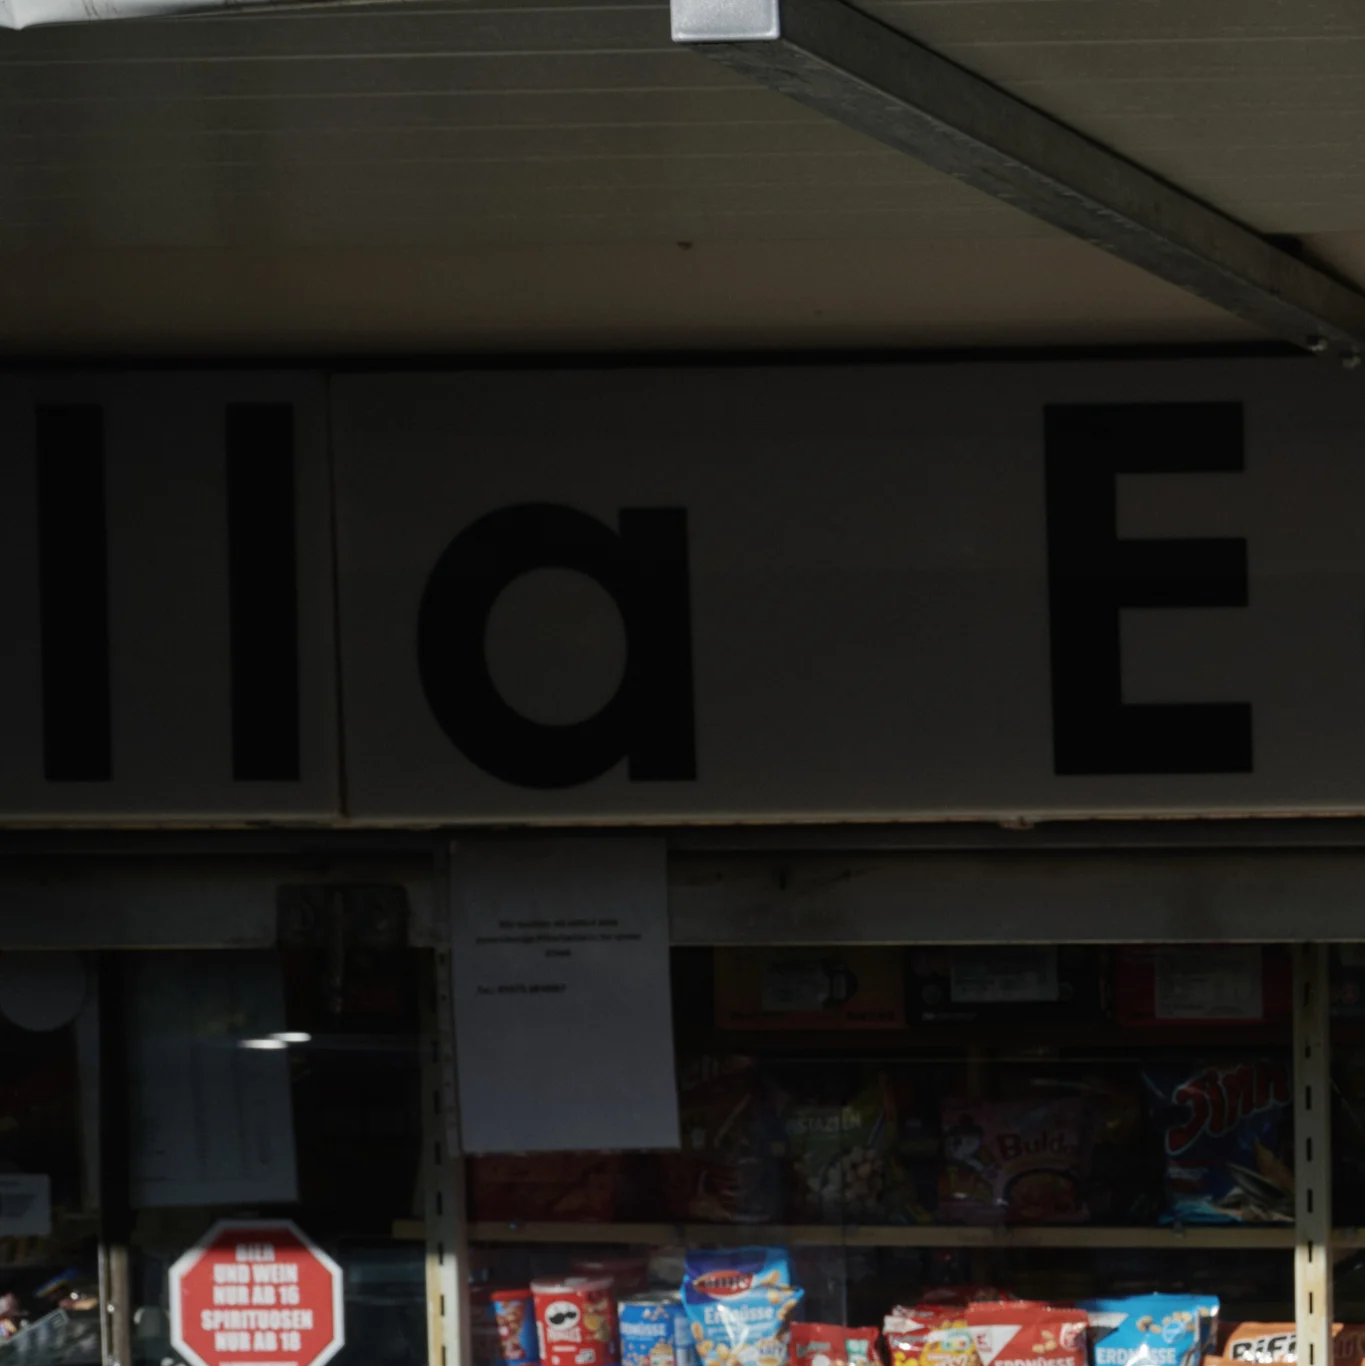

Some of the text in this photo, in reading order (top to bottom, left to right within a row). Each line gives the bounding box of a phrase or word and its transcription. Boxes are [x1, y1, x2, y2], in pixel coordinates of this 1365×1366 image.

[213, 1263, 299, 1283] UND WEIN
[213, 1285, 300, 1306] NUR AB 16
[201, 1308, 314, 1331] SPIRITUOSEN
[214, 1330, 302, 1352] NUR AB 18
